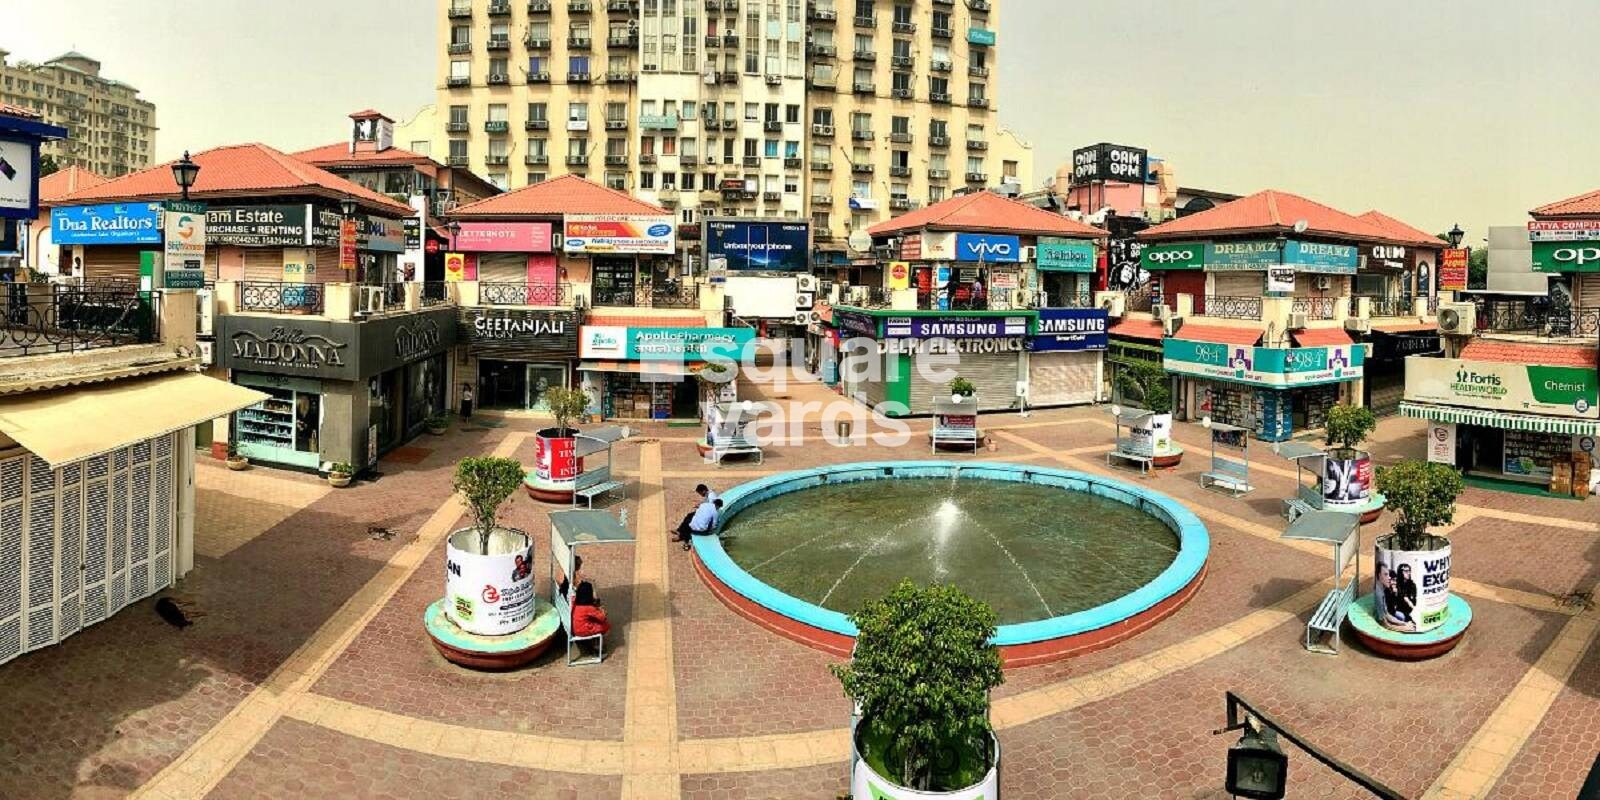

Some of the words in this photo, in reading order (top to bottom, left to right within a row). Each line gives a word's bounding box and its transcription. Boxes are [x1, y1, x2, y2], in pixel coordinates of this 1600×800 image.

[59, 217, 88, 231] Dua
[91, 216, 153, 231] Realtors
[235, 210, 284, 223] Estate
[257, 226, 303, 236] RENTING
[1529, 222, 1560, 231] SATYA
[768, 243, 794, 251] phone
[967, 239, 1013, 256] vivo
[1214, 242, 1278, 256] DREAMZ
[1300, 243, 1351, 259] DREAMZ
[474, 316, 565, 335] GEETANJALI
[920, 323, 997, 336] SAMSUNG
[1038, 318, 1105, 333] SAMSUNG
[636, 330, 681, 345] Apollo
[680, 332, 737, 346] Pharmacy
[232, 338, 345, 367] MADONNA
[876, 337, 924, 356] DELHI
[928, 337, 1024, 355] ELECTRONICS
[1470, 371, 1502, 386] Fortis
[1450, 382, 1509, 396] HEALTHWORLD
[1544, 379, 1586, 394] Chemist
